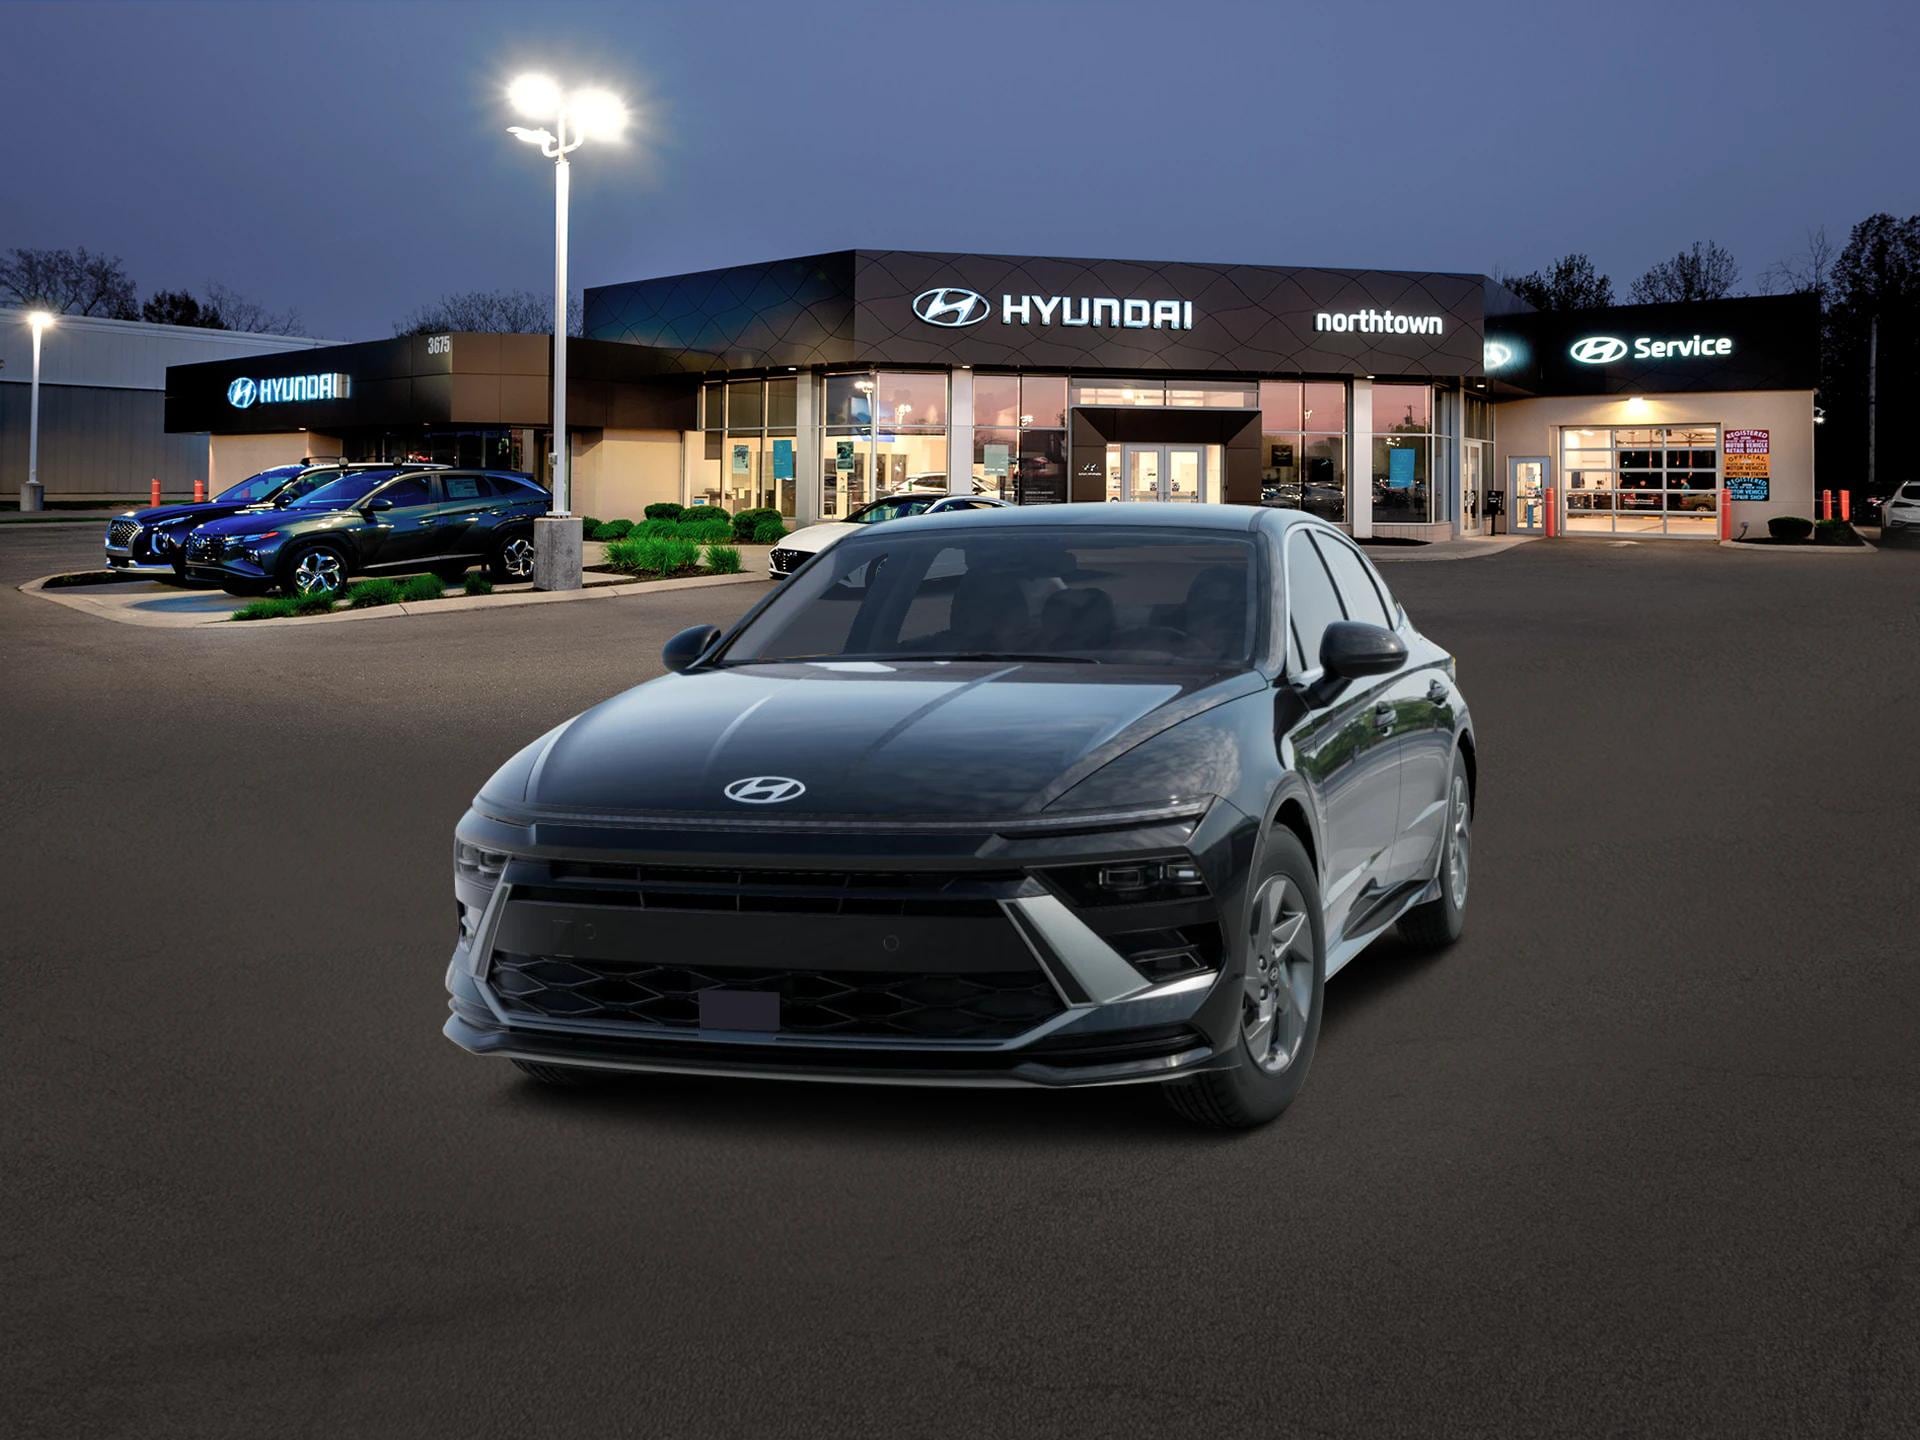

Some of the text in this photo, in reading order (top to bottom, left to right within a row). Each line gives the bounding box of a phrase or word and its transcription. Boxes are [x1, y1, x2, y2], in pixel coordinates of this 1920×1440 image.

[1002, 294, 1193, 331] HYUNDAI
[1315, 308, 1444, 335] northtown
[427, 335, 451, 355] 3675
[1633, 334, 1733, 360] Service
[259, 373, 340, 403] HYUNDAI
[1726, 430, 1768, 439] REGISTERED
[1726, 477, 1768, 486] REGISTERED
